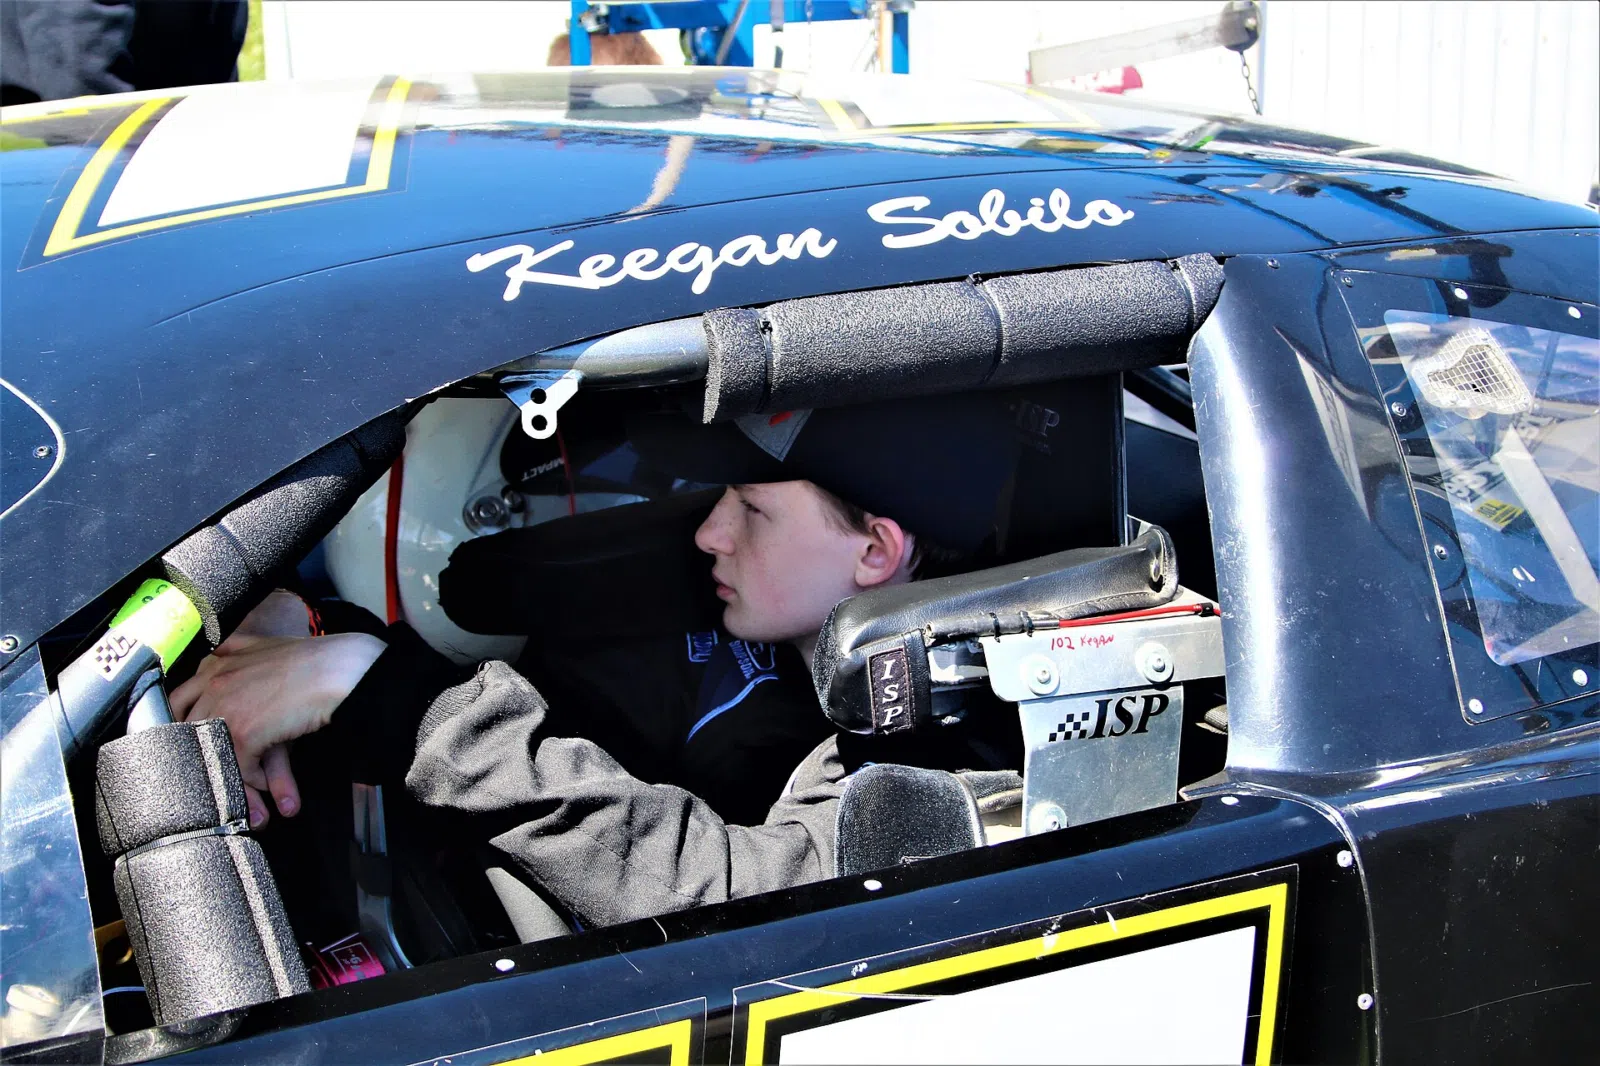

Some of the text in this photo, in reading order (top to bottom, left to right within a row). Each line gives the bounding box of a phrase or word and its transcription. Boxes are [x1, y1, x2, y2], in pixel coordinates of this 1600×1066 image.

[466, 189, 1134, 302] Keegan Sobilo
[521, 457, 566, 481] MPACT
[1051, 636, 1075, 651] 102
[880, 658, 903, 727] ISP
[1088, 693, 1170, 740] ISP
